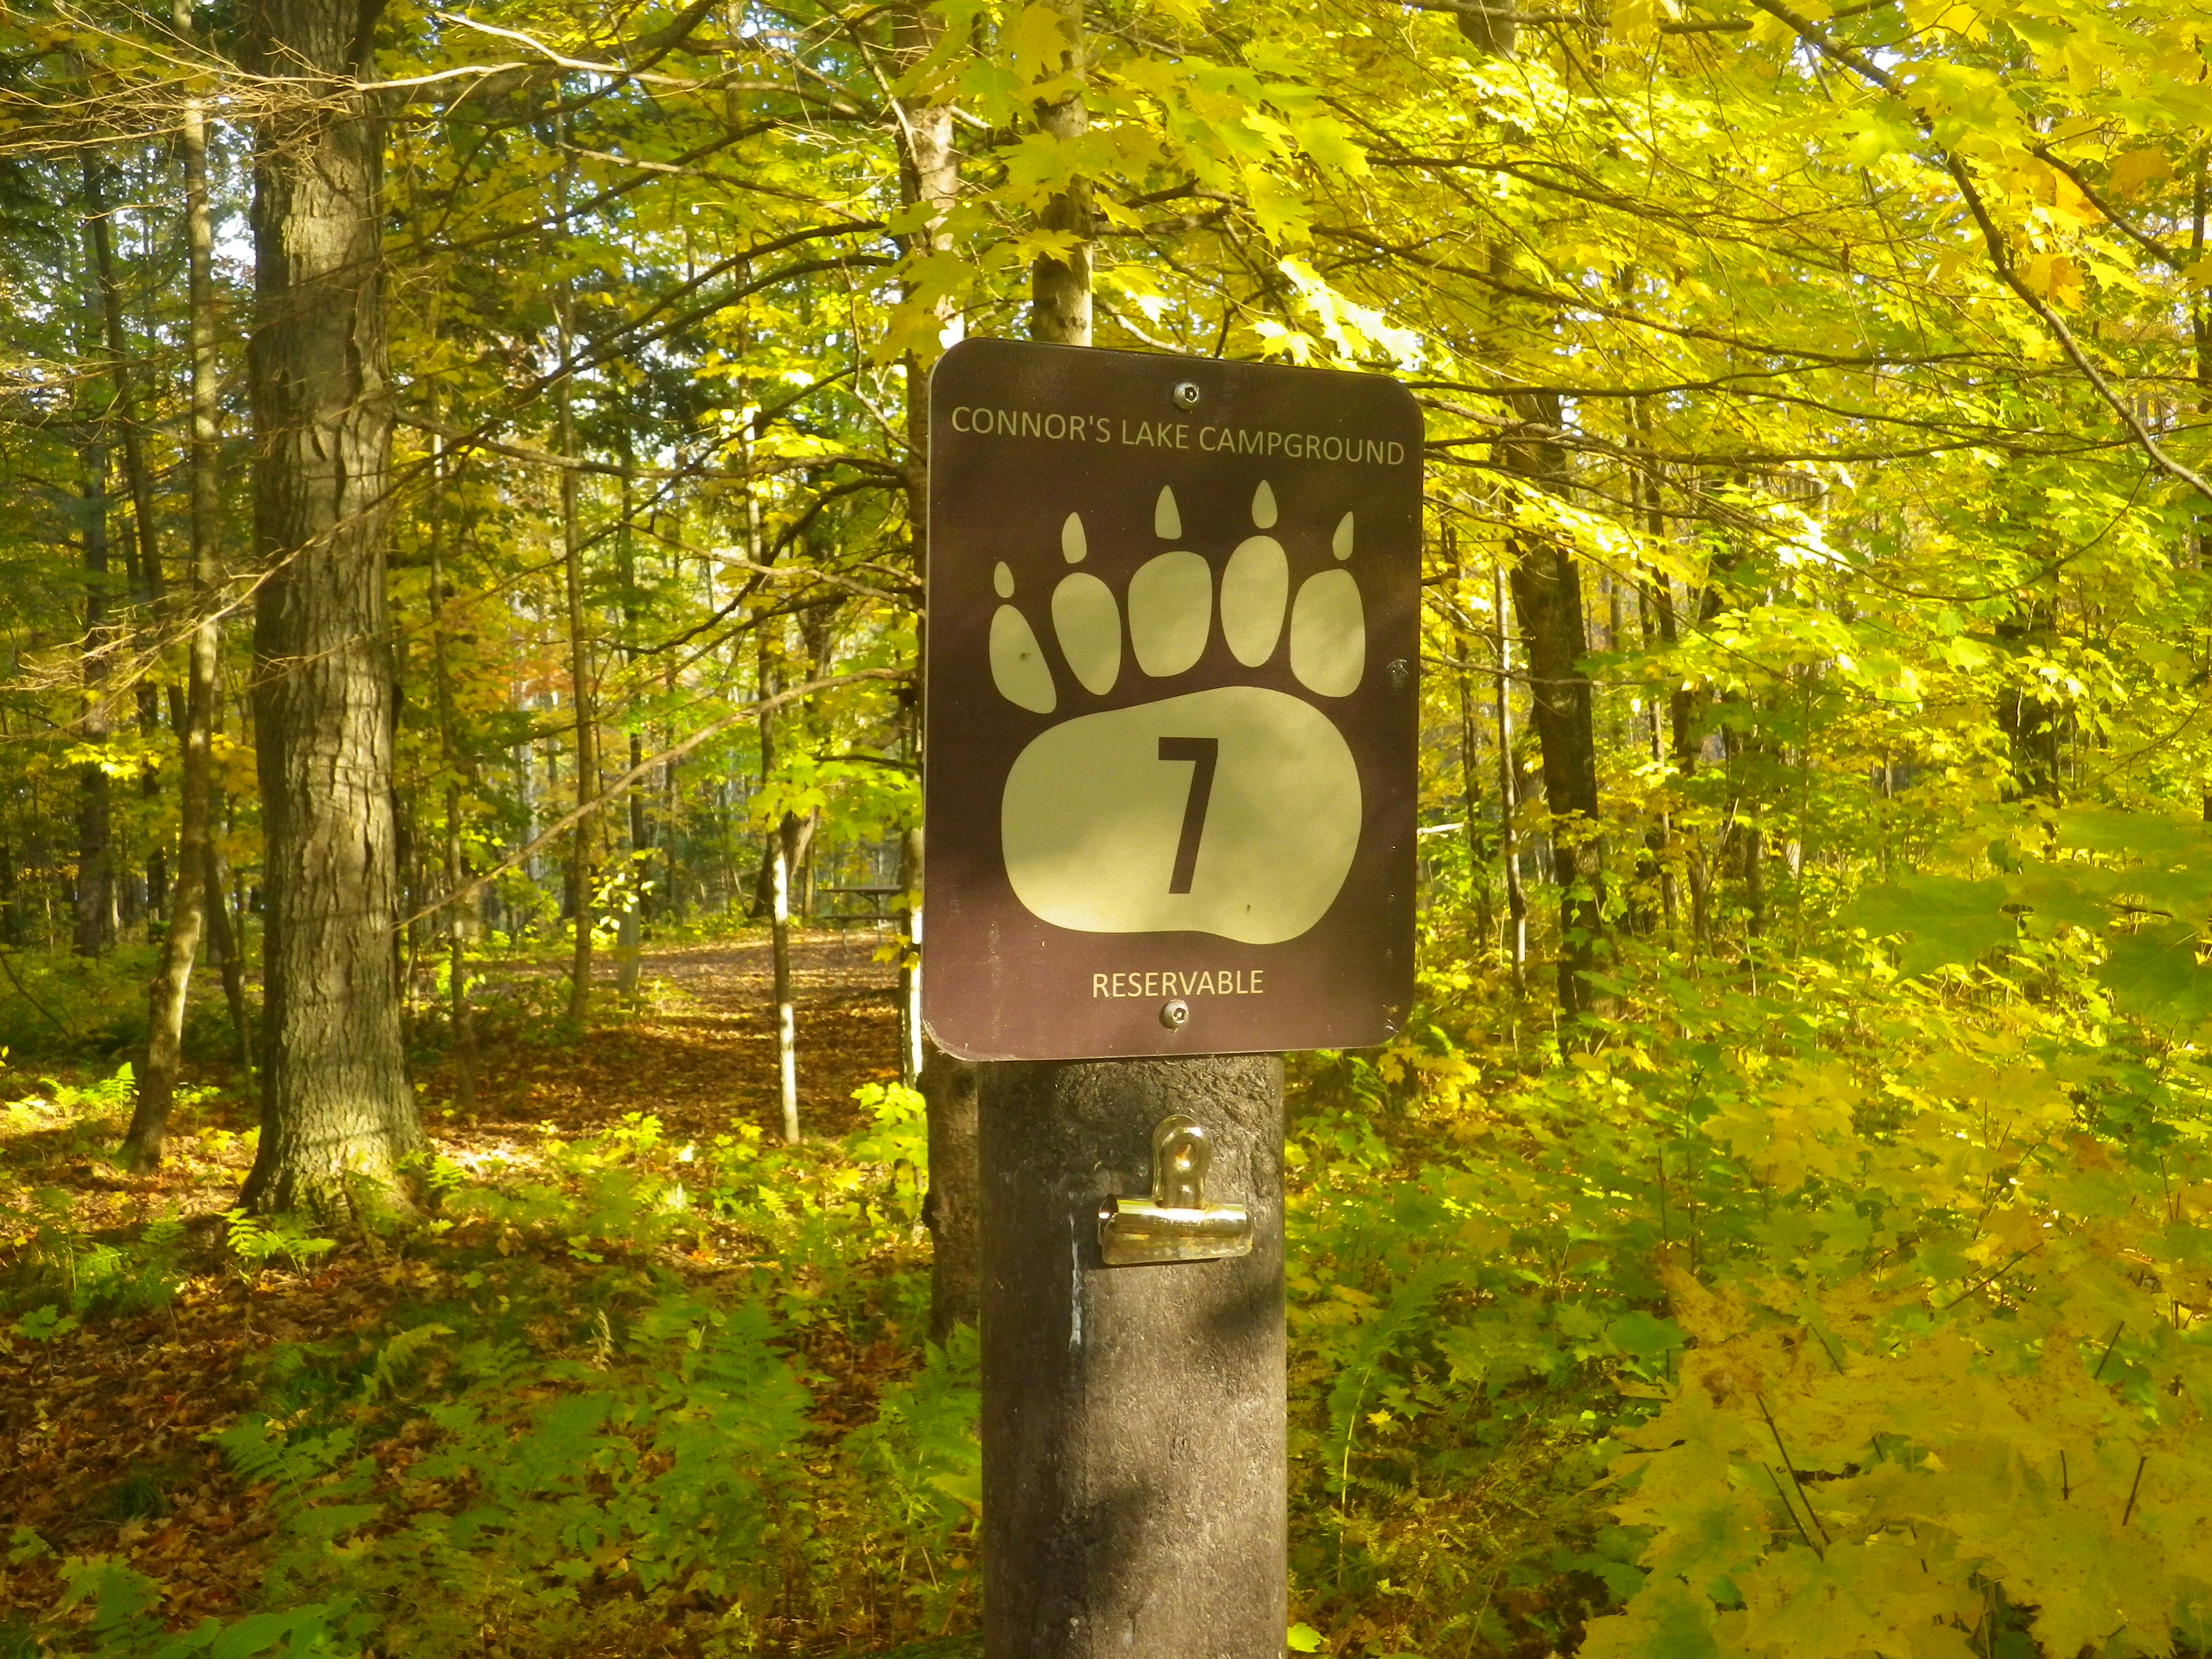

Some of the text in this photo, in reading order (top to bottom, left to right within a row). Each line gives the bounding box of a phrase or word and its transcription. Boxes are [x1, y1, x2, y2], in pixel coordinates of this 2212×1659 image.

[952, 406, 1404, 465] CONNOR'S LAKE CAMPGROUND
[1159, 737, 1218, 893] 7
[1093, 970, 1263, 998] RESERVABLE
